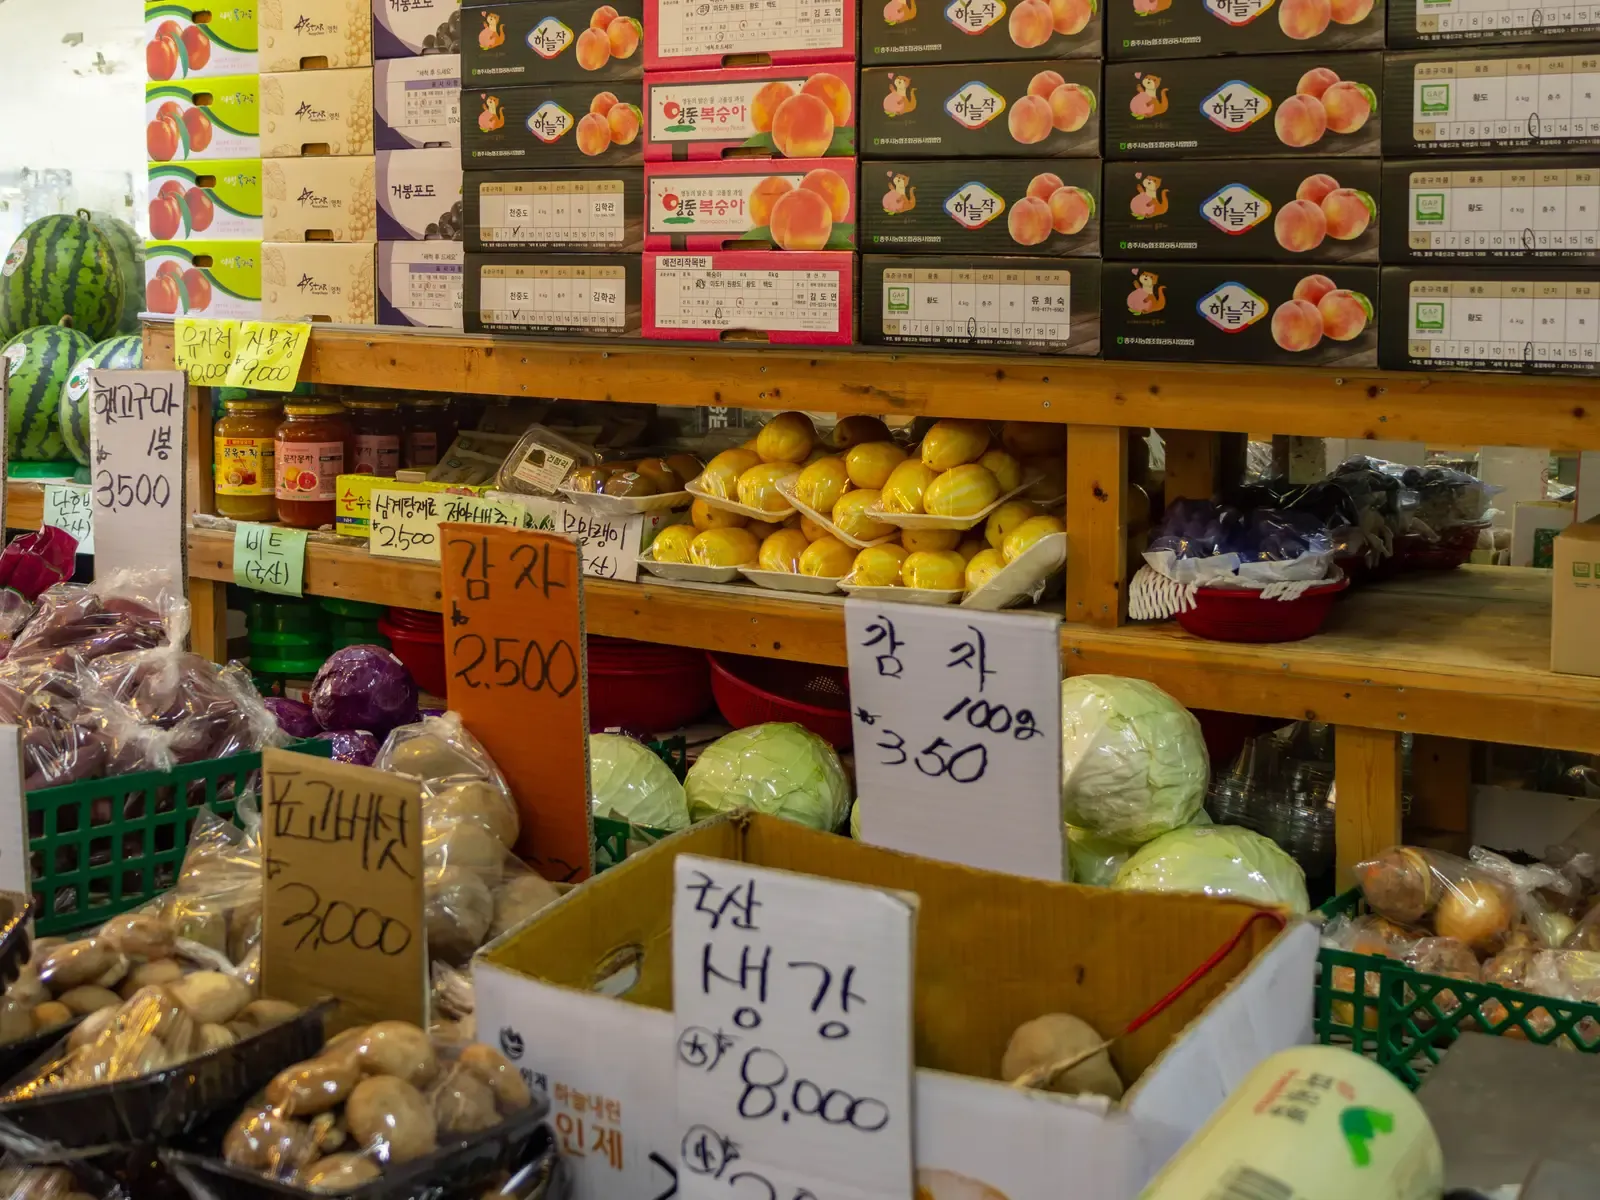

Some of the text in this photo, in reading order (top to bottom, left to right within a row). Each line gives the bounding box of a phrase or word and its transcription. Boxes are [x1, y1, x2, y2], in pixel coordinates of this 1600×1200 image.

[955, 0, 996, 26] 하늘작
[1458, 18, 1463, 26] 7
[1501, 16, 1510, 24] 10
[1578, 12, 1587, 20] 15
[534, 28, 566, 52] 하늘작
[954, 94, 996, 120] 하늘작
[1212, 93, 1260, 122] 하늘작
[1472, 93, 1488, 101] 황도
[534, 111, 566, 136] 하늘작
[700, 105, 747, 124] 복숭아
[1440, 128, 1445, 136] 6
[1456, 127, 1460, 135] 7
[1469, 126, 1475, 135] 8
[1484, 126, 1490, 135] 9
[1498, 126, 1507, 134] 10
[1544, 125, 1552, 133] 13
[1559, 124, 1568, 132] 14
[1575, 124, 1584, 132] 15
[1591, 123, 1599, 131] 16
[392, 183, 436, 198] 거봉포도
[509, 208, 528, 217] 천중도
[594, 202, 614, 212] 김학관
[699, 199, 745, 216] 복숭아
[954, 193, 995, 221] 하늘작
[1212, 196, 1260, 226] 하늘작
[1468, 204, 1483, 212] 황도
[510, 292, 528, 301] 천중도
[593, 292, 616, 303] 김학관
[1209, 294, 1257, 323] 하늘작
[183, 326, 231, 359] 유자청
[245, 328, 300, 358] 자몽청
[1464, 346, 1470, 354] 8
[1538, 348, 1546, 356] 13
[94, 377, 180, 425] 햇고구마
[341, 488, 358, 511] 순
[376, 494, 439, 520] 삼계탕재료
[246, 531, 284, 560] 비트
[245, 561, 289, 585] (국산)
[943, 697, 1045, 740] 100g
[876, 729, 988, 783] 350
[267, 771, 415, 880] 표고버섯
[686, 871, 763, 930] 국산
[554, 1082, 621, 1124] 하늘내린
[556, 1112, 623, 1171] 인제
